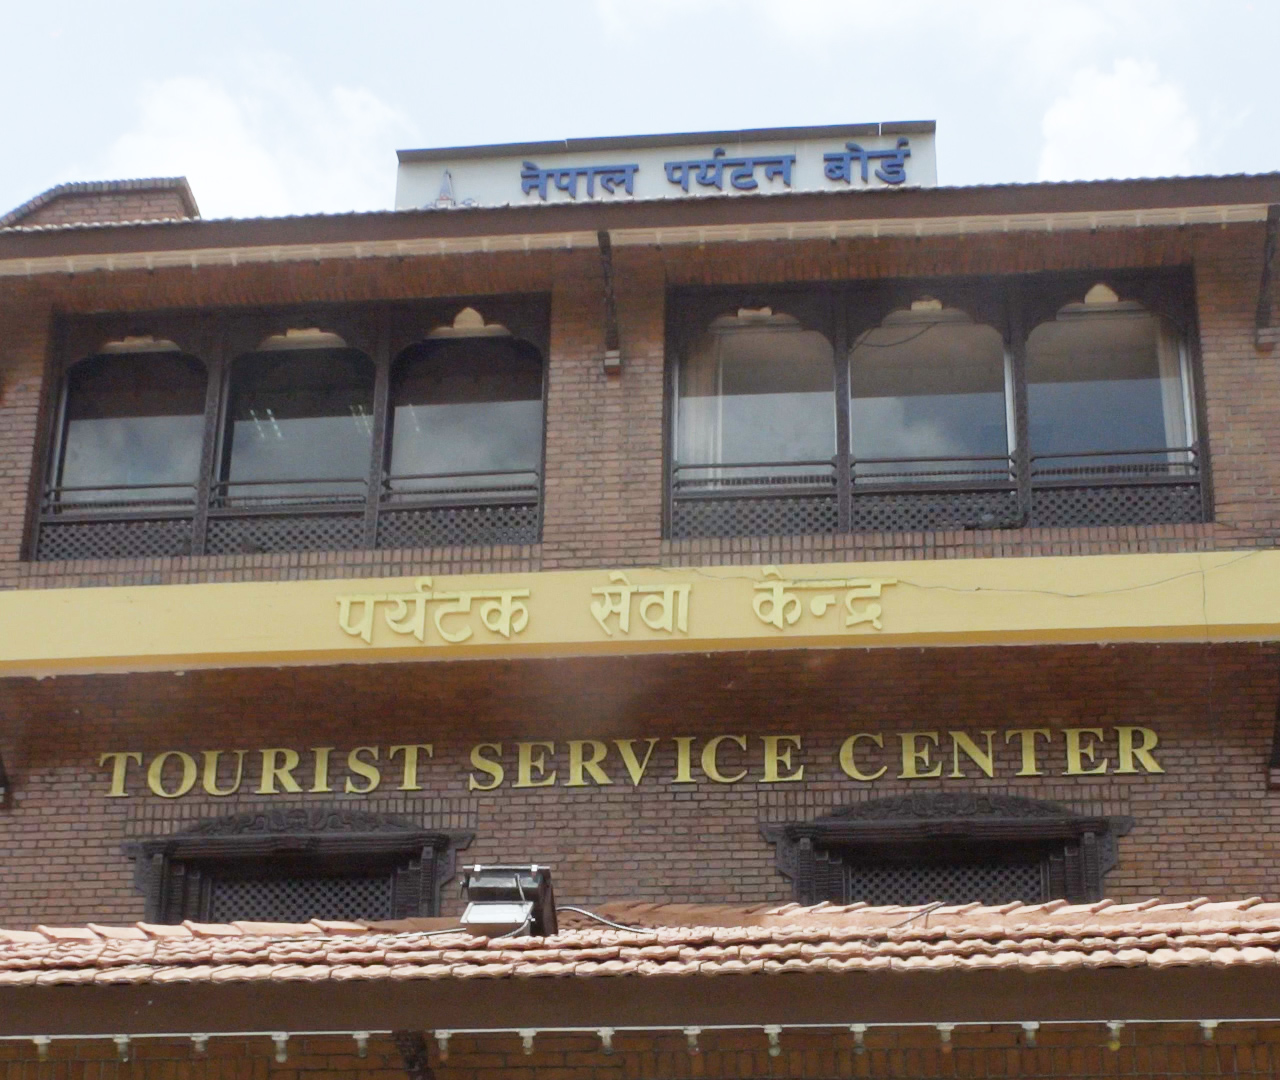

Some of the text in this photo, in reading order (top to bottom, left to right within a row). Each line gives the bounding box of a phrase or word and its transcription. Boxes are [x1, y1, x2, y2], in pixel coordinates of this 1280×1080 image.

[519, 137, 912, 198] नेपाल पर्यटन बोर्ड
[335, 565, 899, 644] पर्यटक सेवा केन्द्र
[98, 725, 1166, 799] TOURIST SERVICE CENTER
